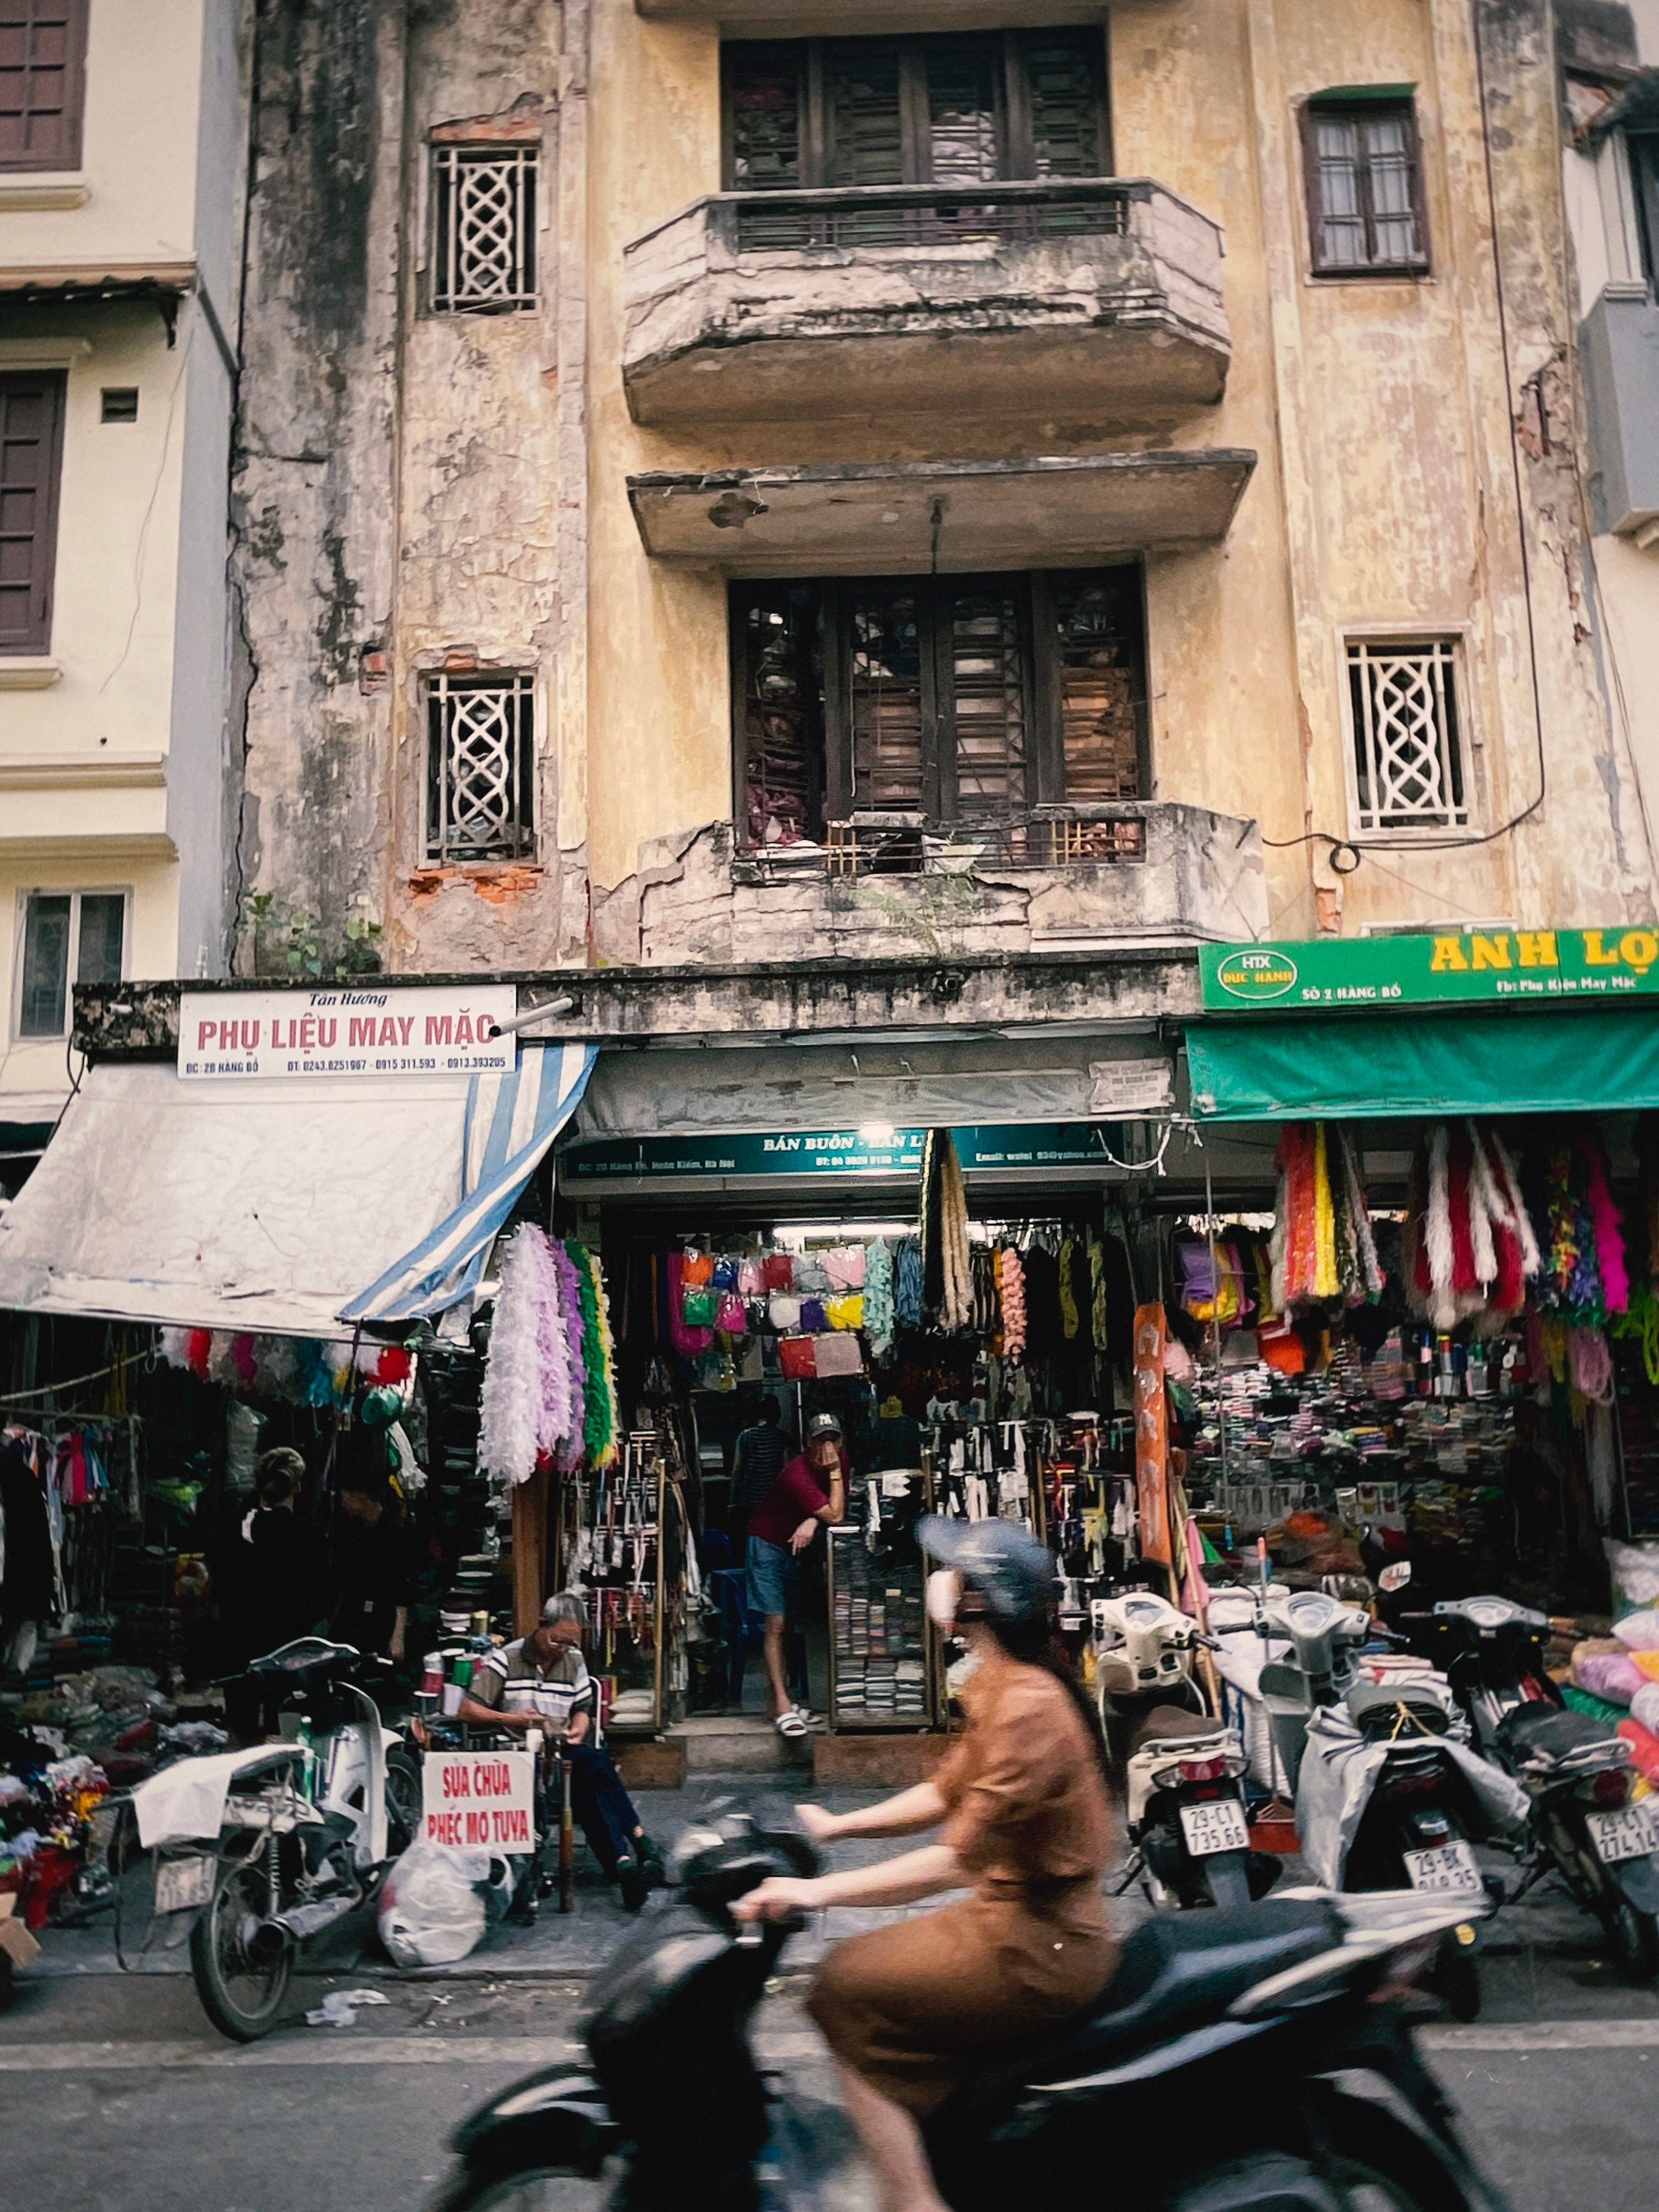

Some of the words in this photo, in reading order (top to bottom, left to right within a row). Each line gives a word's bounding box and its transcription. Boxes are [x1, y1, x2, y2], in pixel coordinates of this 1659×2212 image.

[1242, 955, 1271, 969] HTX
[1431, 931, 1559, 972] ANH
[1581, 975, 1606, 990] May
[198, 1019, 260, 1056] PHỤ
[272, 1012, 337, 1054] LIỆU
[349, 1016, 415, 1047] MAY
[425, 1007, 495, 1051] MẶC
[763, 1135, 801, 1152] BÁN
[804, 1134, 854, 1150] BUÔN
[491, 1810, 529, 1843] TUYA
[1190, 1805, 1234, 1830] 29-C1
[1190, 1825, 1245, 1852] 735.66
